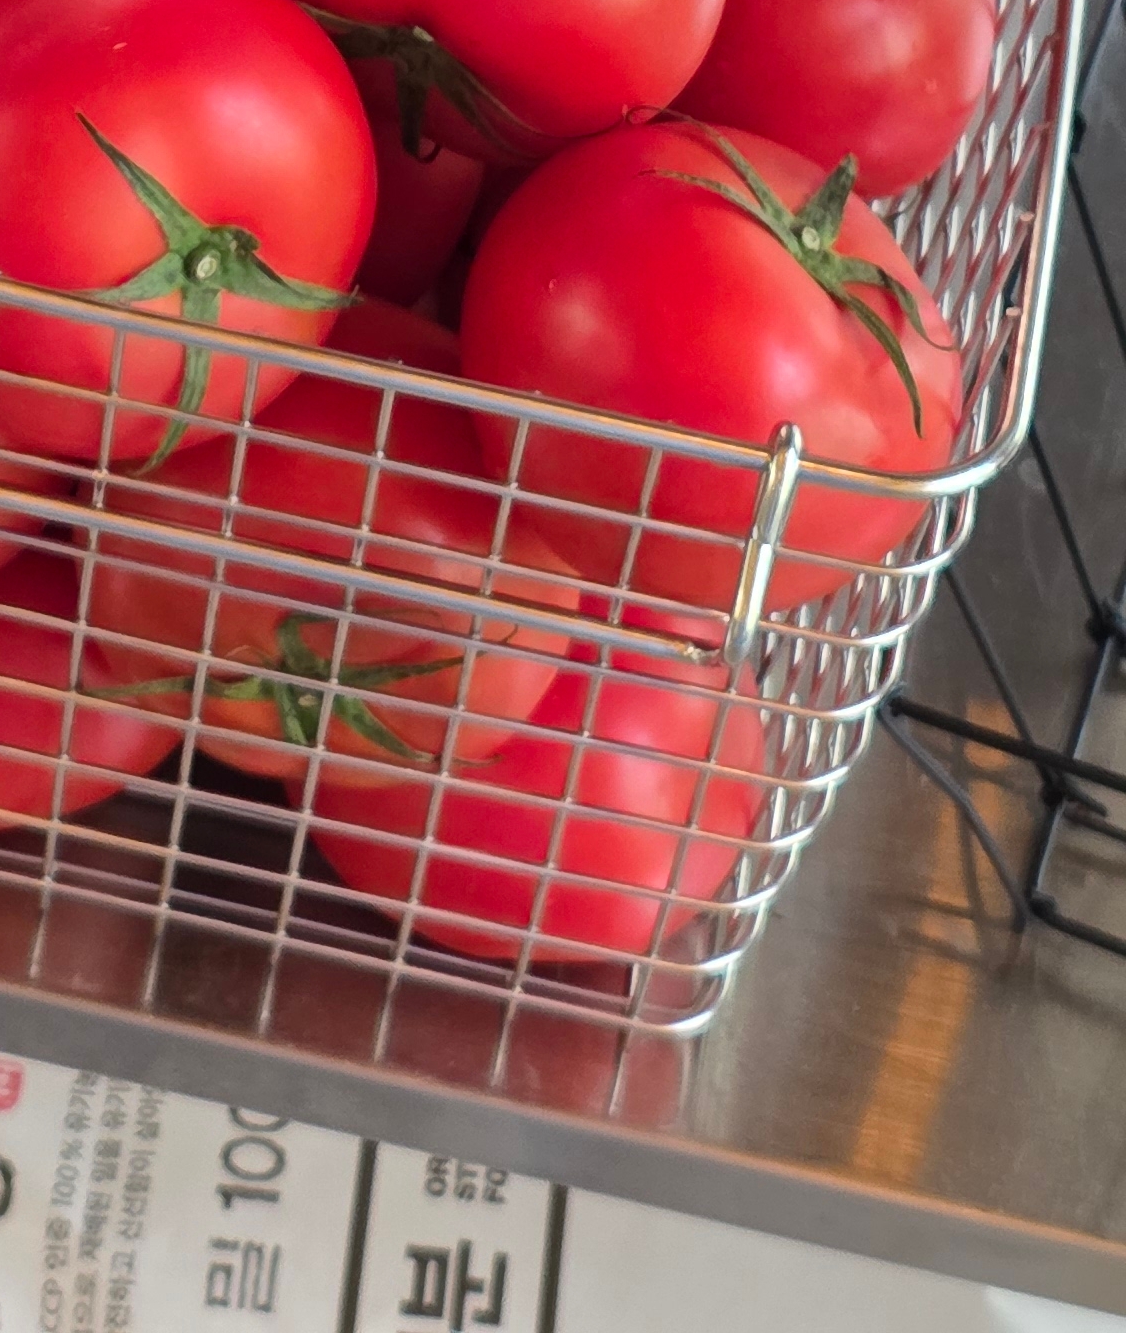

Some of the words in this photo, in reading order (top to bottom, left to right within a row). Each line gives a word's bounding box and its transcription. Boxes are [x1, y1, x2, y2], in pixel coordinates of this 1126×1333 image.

[50, 1138, 83, 1207] 100%
[40, 1278, 65, 1333] CCP
[104, 1250, 137, 1333] 전하고
[204, 1237, 281, 1314] 밀
[397, 1238, 510, 1333] 분
